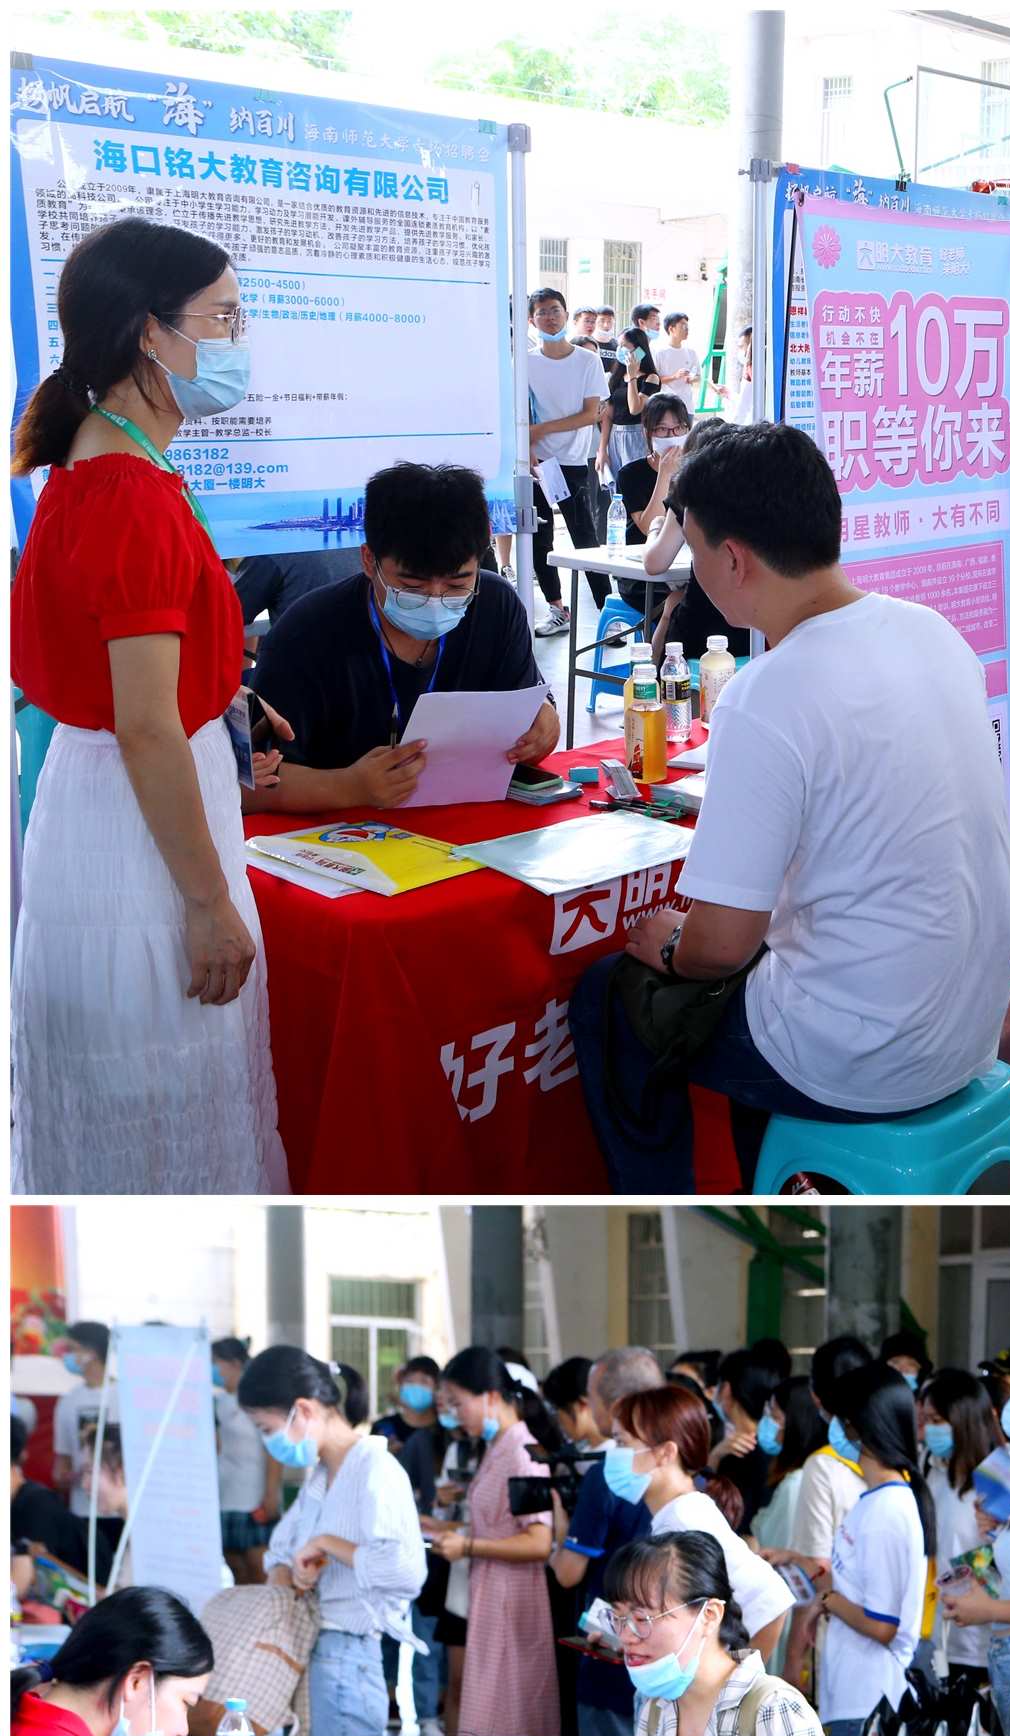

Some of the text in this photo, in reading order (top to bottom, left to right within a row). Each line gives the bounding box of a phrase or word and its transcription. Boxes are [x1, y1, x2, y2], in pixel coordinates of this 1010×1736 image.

[93, 140, 449, 203] 海口铭大教育咨询有限公司
[821, 304, 881, 325] 行动不快
[825, 329, 881, 346] 机会不在
[819, 304, 1003, 399] 年薪 10万
[826, 402, 1006, 482] 职等你来
